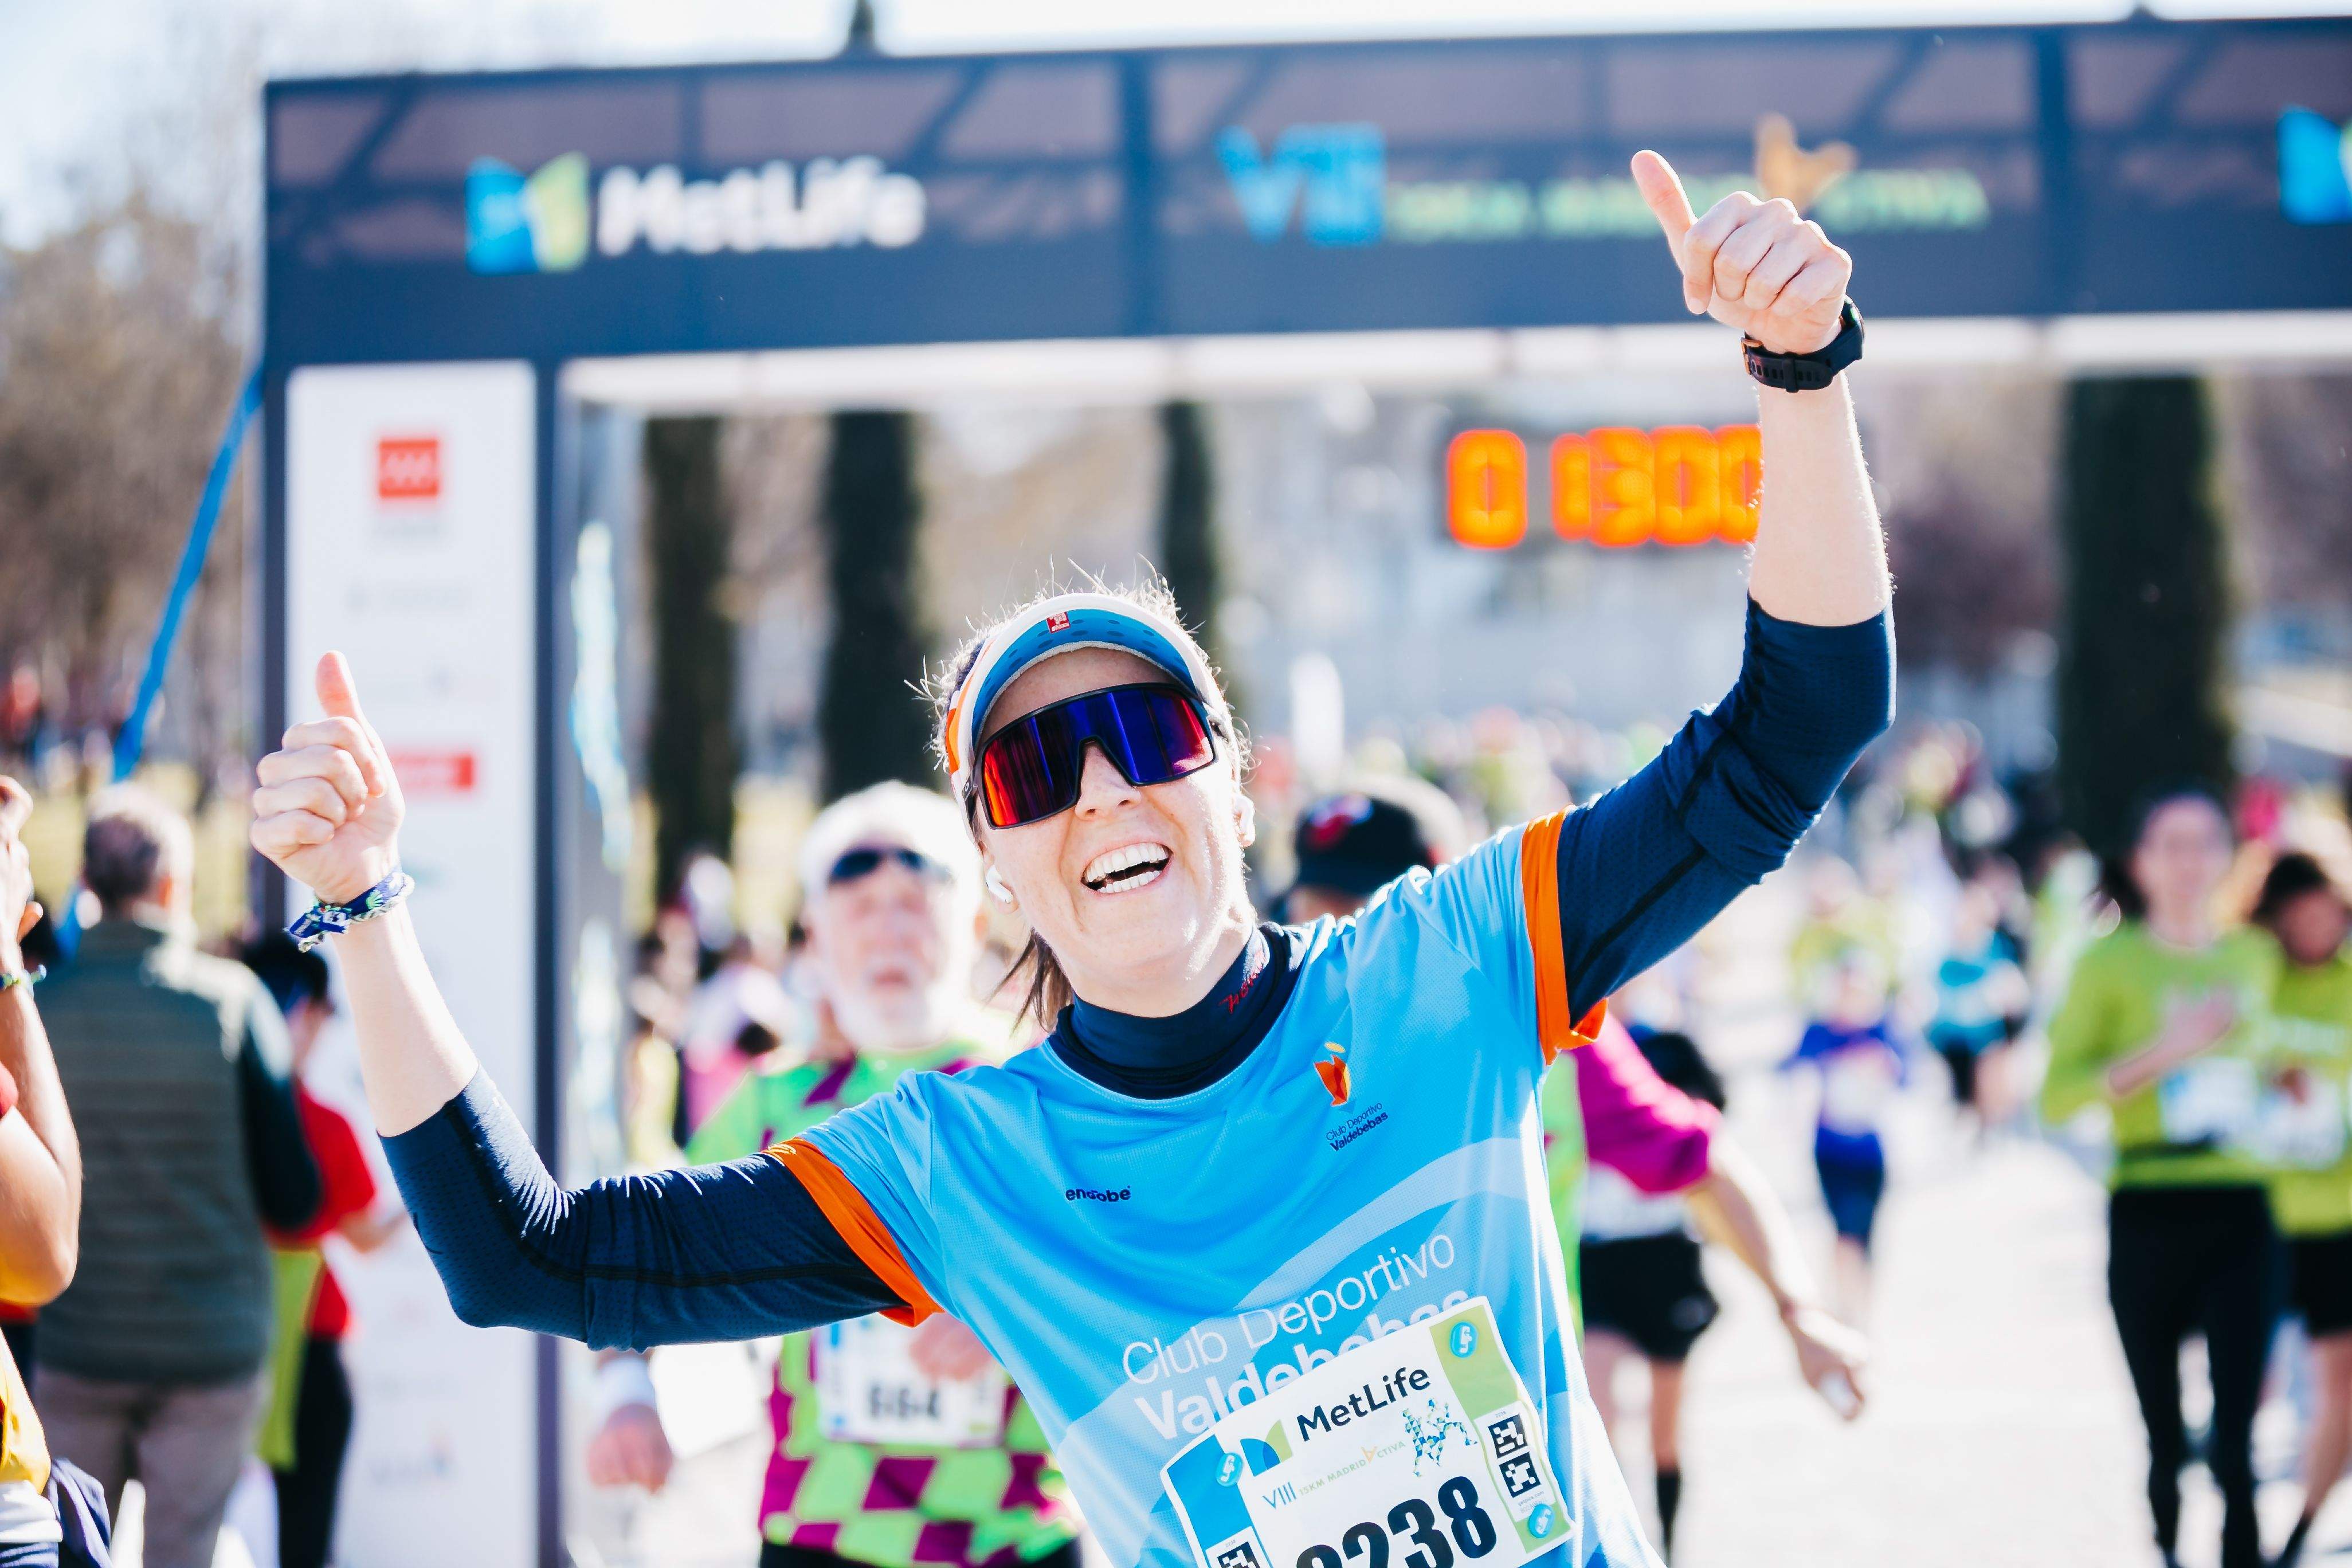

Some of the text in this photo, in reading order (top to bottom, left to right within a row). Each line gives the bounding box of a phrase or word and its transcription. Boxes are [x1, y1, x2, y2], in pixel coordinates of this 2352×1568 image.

[1326, 1103, 1383, 1140] Club Deportivo
[1330, 1112, 1389, 1151] Valdebebas
[1123, 1234, 1455, 1385] Club Deportivo
[1296, 1367, 1431, 1442] MetLife
[1261, 1481, 1297, 1510] VIII
[1299, 1479, 1325, 1496] 15KM
[1327, 1459, 1366, 1483] MADRID
